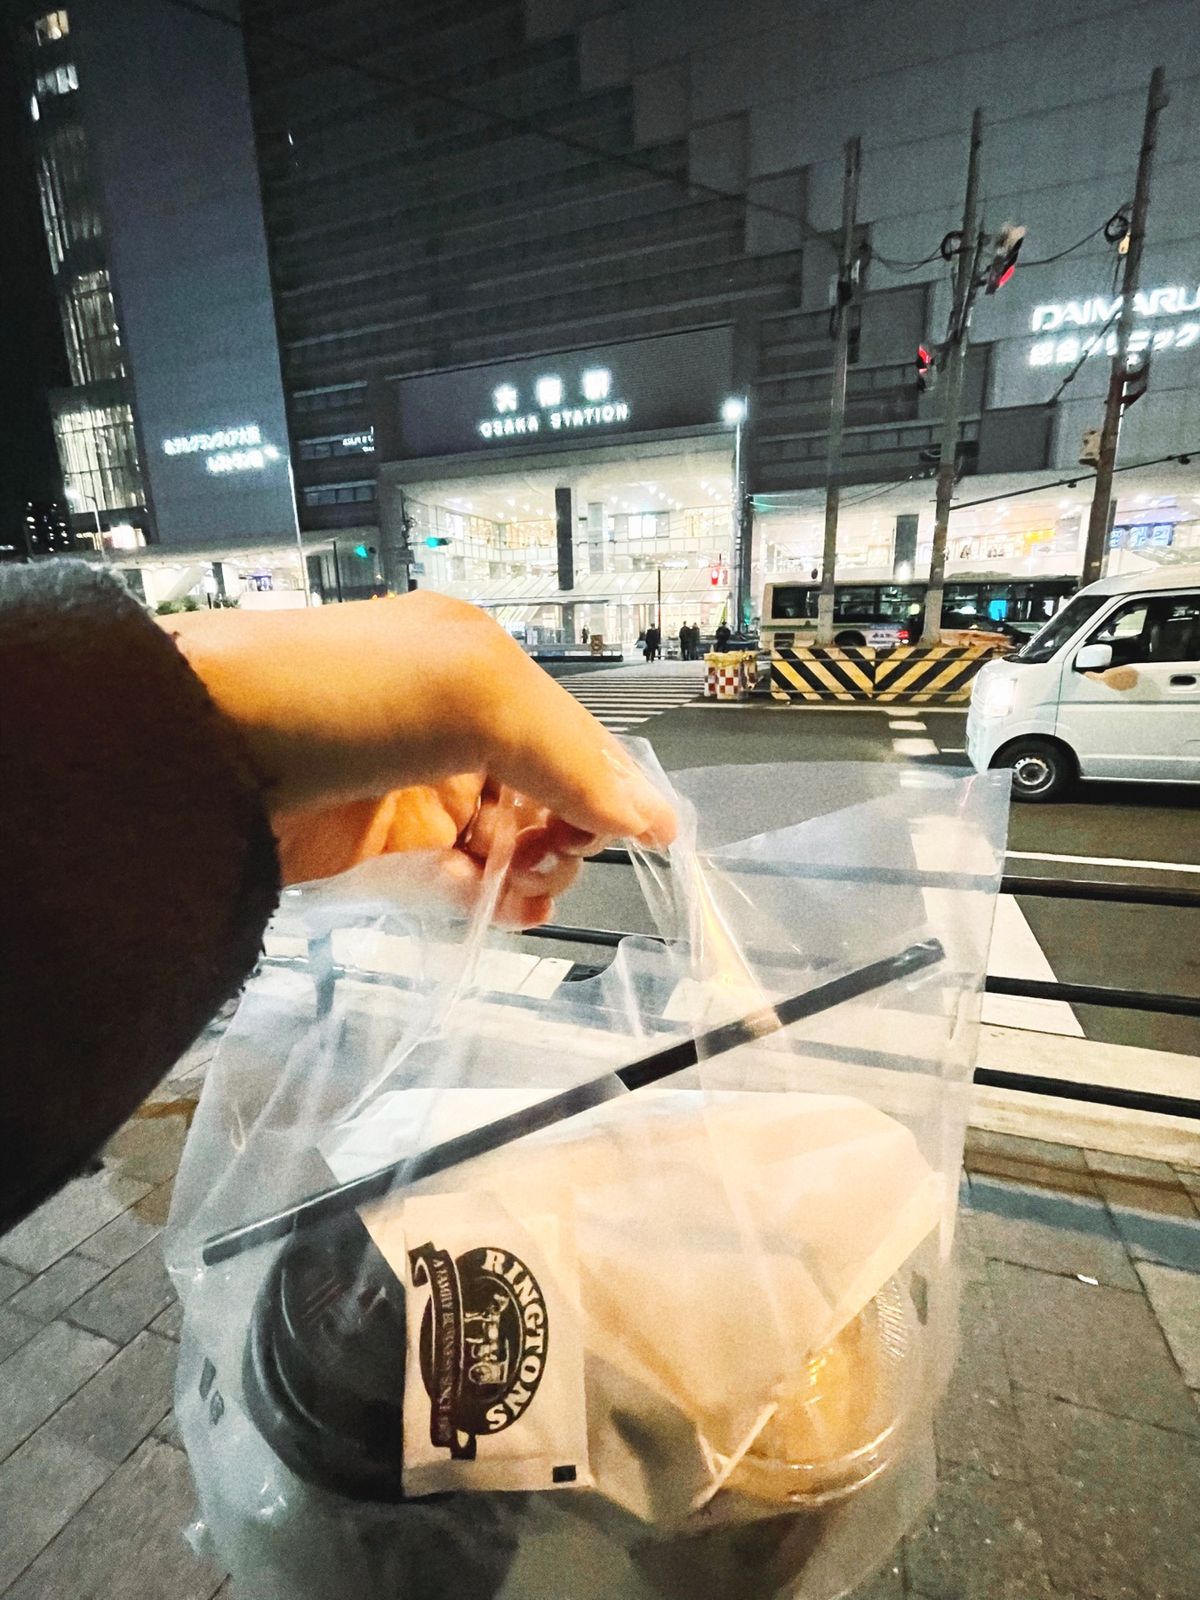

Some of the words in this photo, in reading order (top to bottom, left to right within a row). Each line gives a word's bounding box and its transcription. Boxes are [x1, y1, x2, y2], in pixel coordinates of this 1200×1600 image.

[480, 415, 539, 437] OSAKA
[550, 404, 628, 429] STATION
[481, 1249, 544, 1430] RINGTONS
